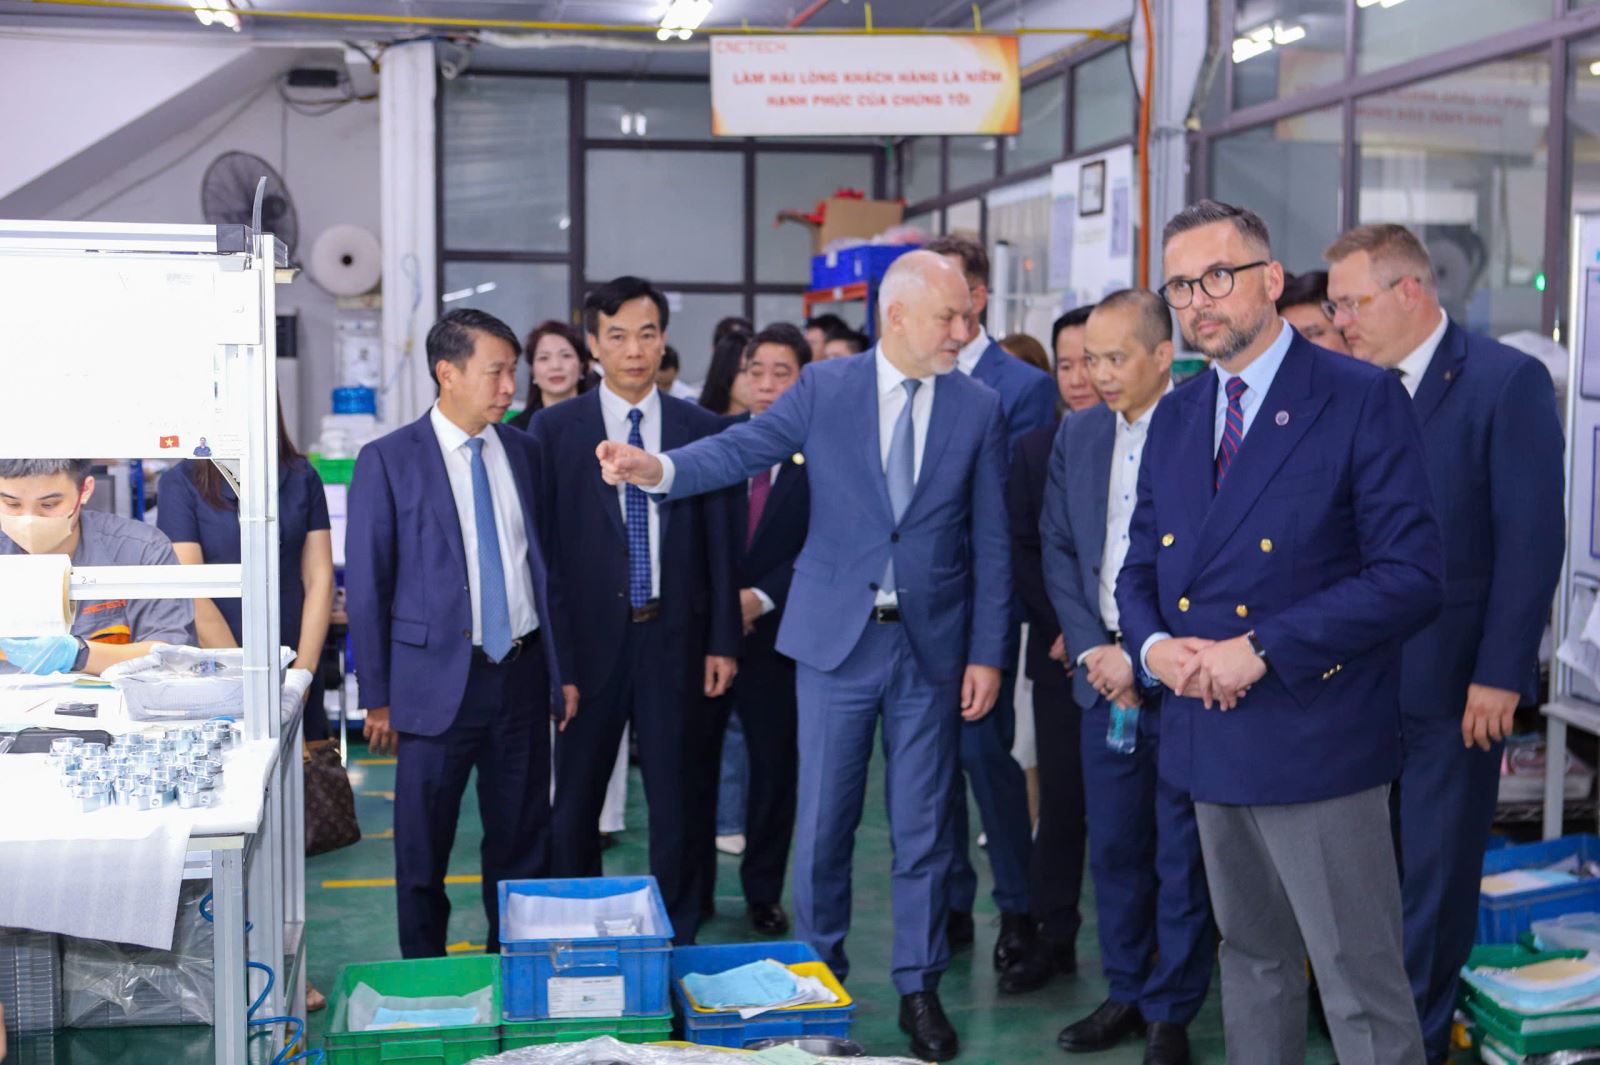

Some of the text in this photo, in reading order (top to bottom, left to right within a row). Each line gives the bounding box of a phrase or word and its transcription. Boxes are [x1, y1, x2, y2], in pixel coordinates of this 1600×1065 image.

[715, 40, 786, 53] CNCTECH
[733, 70, 765, 84] LÀM
[799, 70, 838, 84] LÒNG
[842, 70, 893, 84] KHÁCH
[898, 70, 938, 83] HÀNG
[943, 70, 960, 83] LÀ
[812, 93, 851, 107] PHÚC
